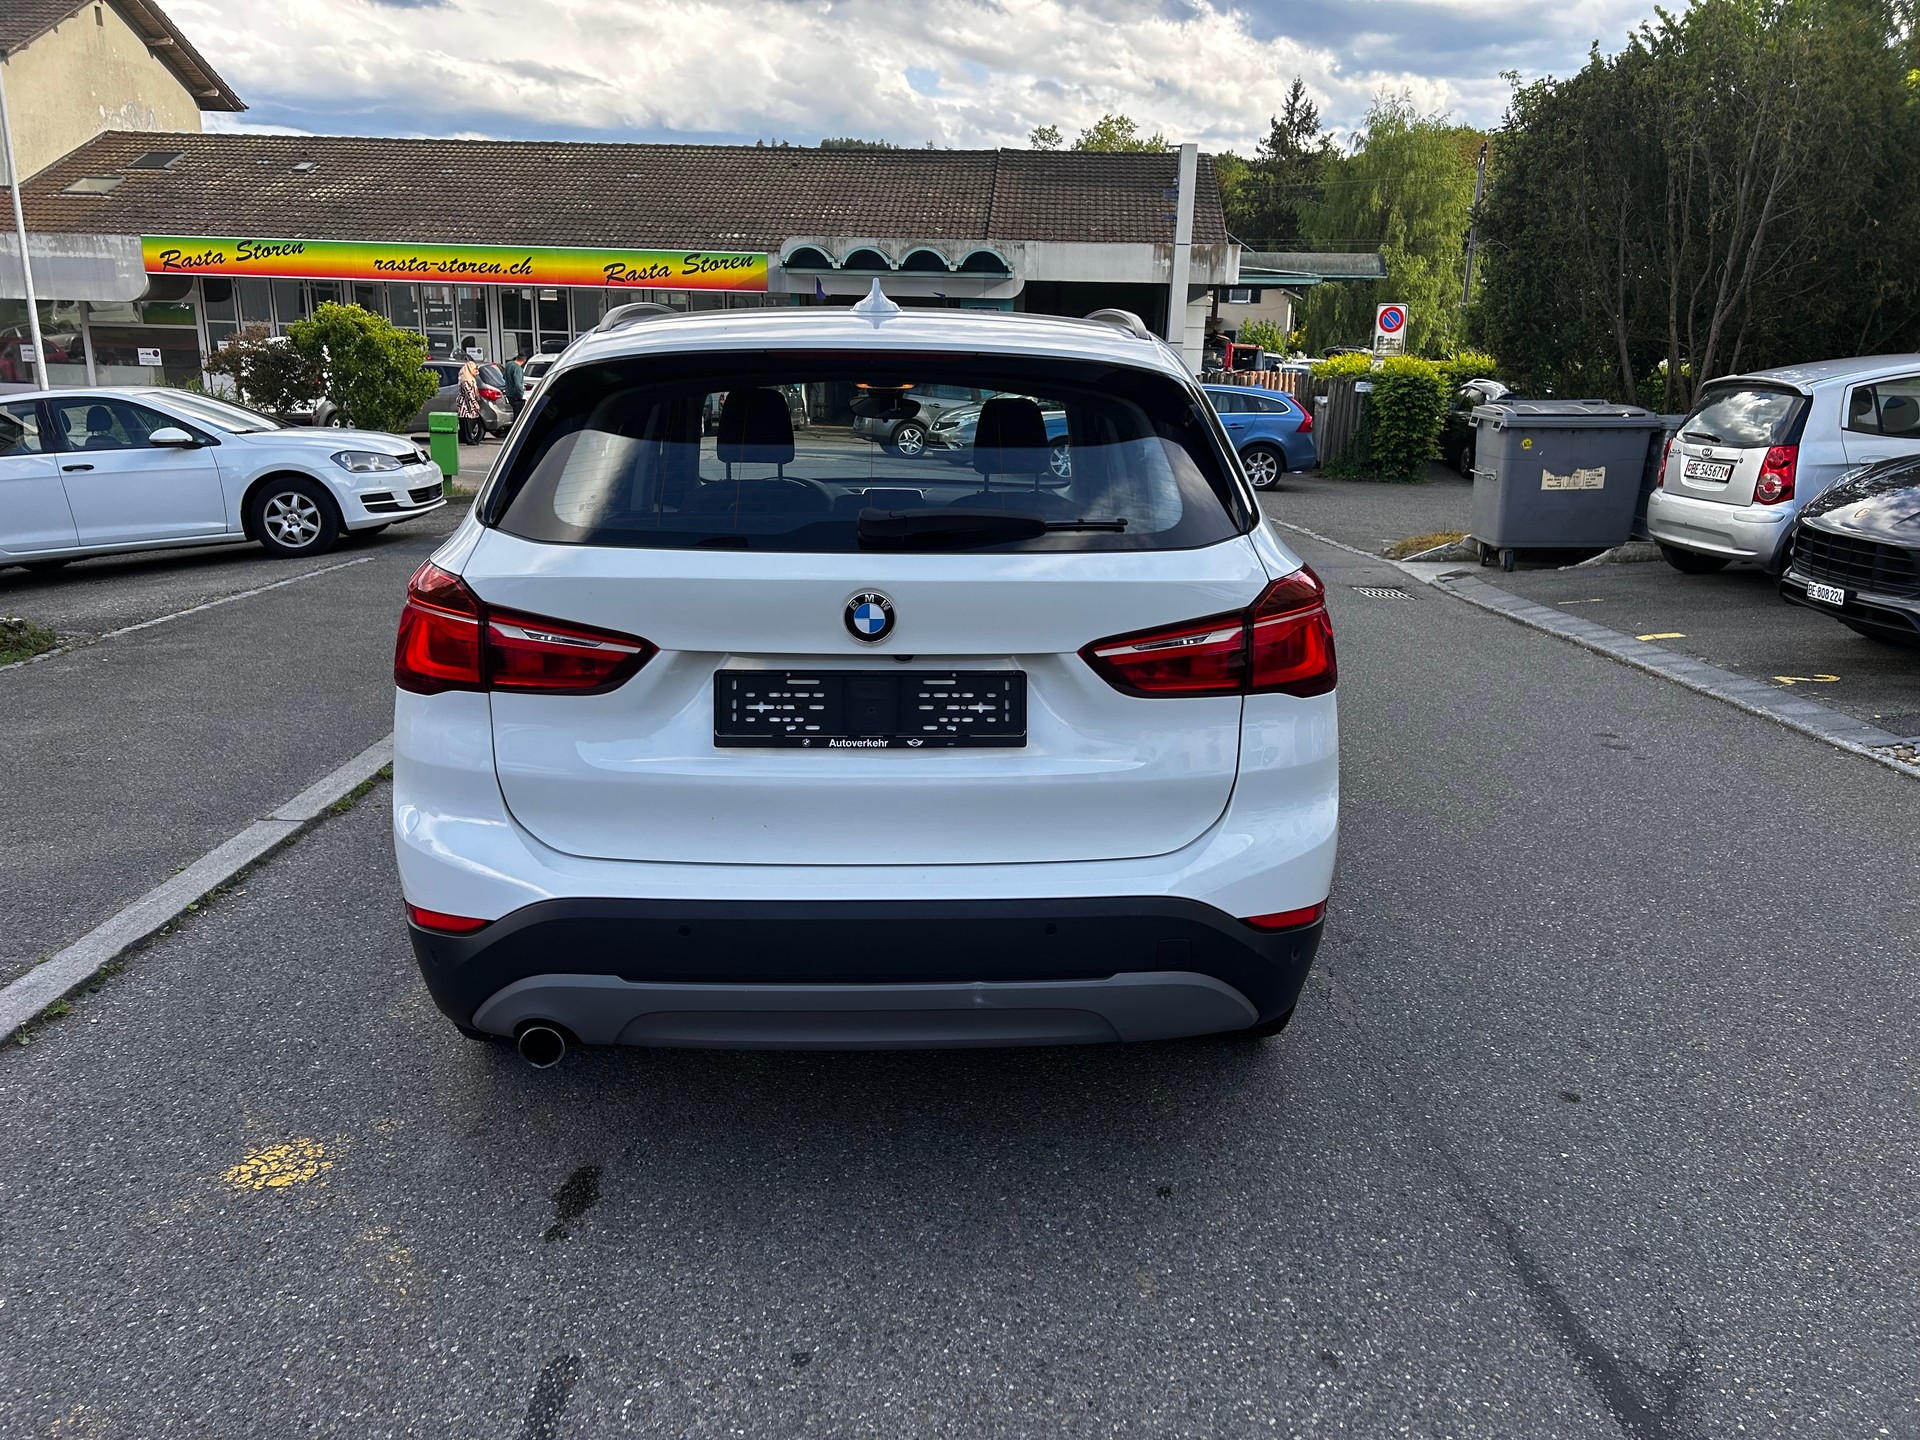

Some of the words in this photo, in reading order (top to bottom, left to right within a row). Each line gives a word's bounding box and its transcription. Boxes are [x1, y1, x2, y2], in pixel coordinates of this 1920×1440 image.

[159, 249, 227, 272] Rasta
[235, 239, 306, 262] Storen
[373, 256, 533, 275] rasta-storen.ch
[602, 262, 672, 285] Rasta
[681, 252, 755, 275] Storen
[848, 594, 891, 611] BMW
[828, 738, 889, 748] Autoverkehr
